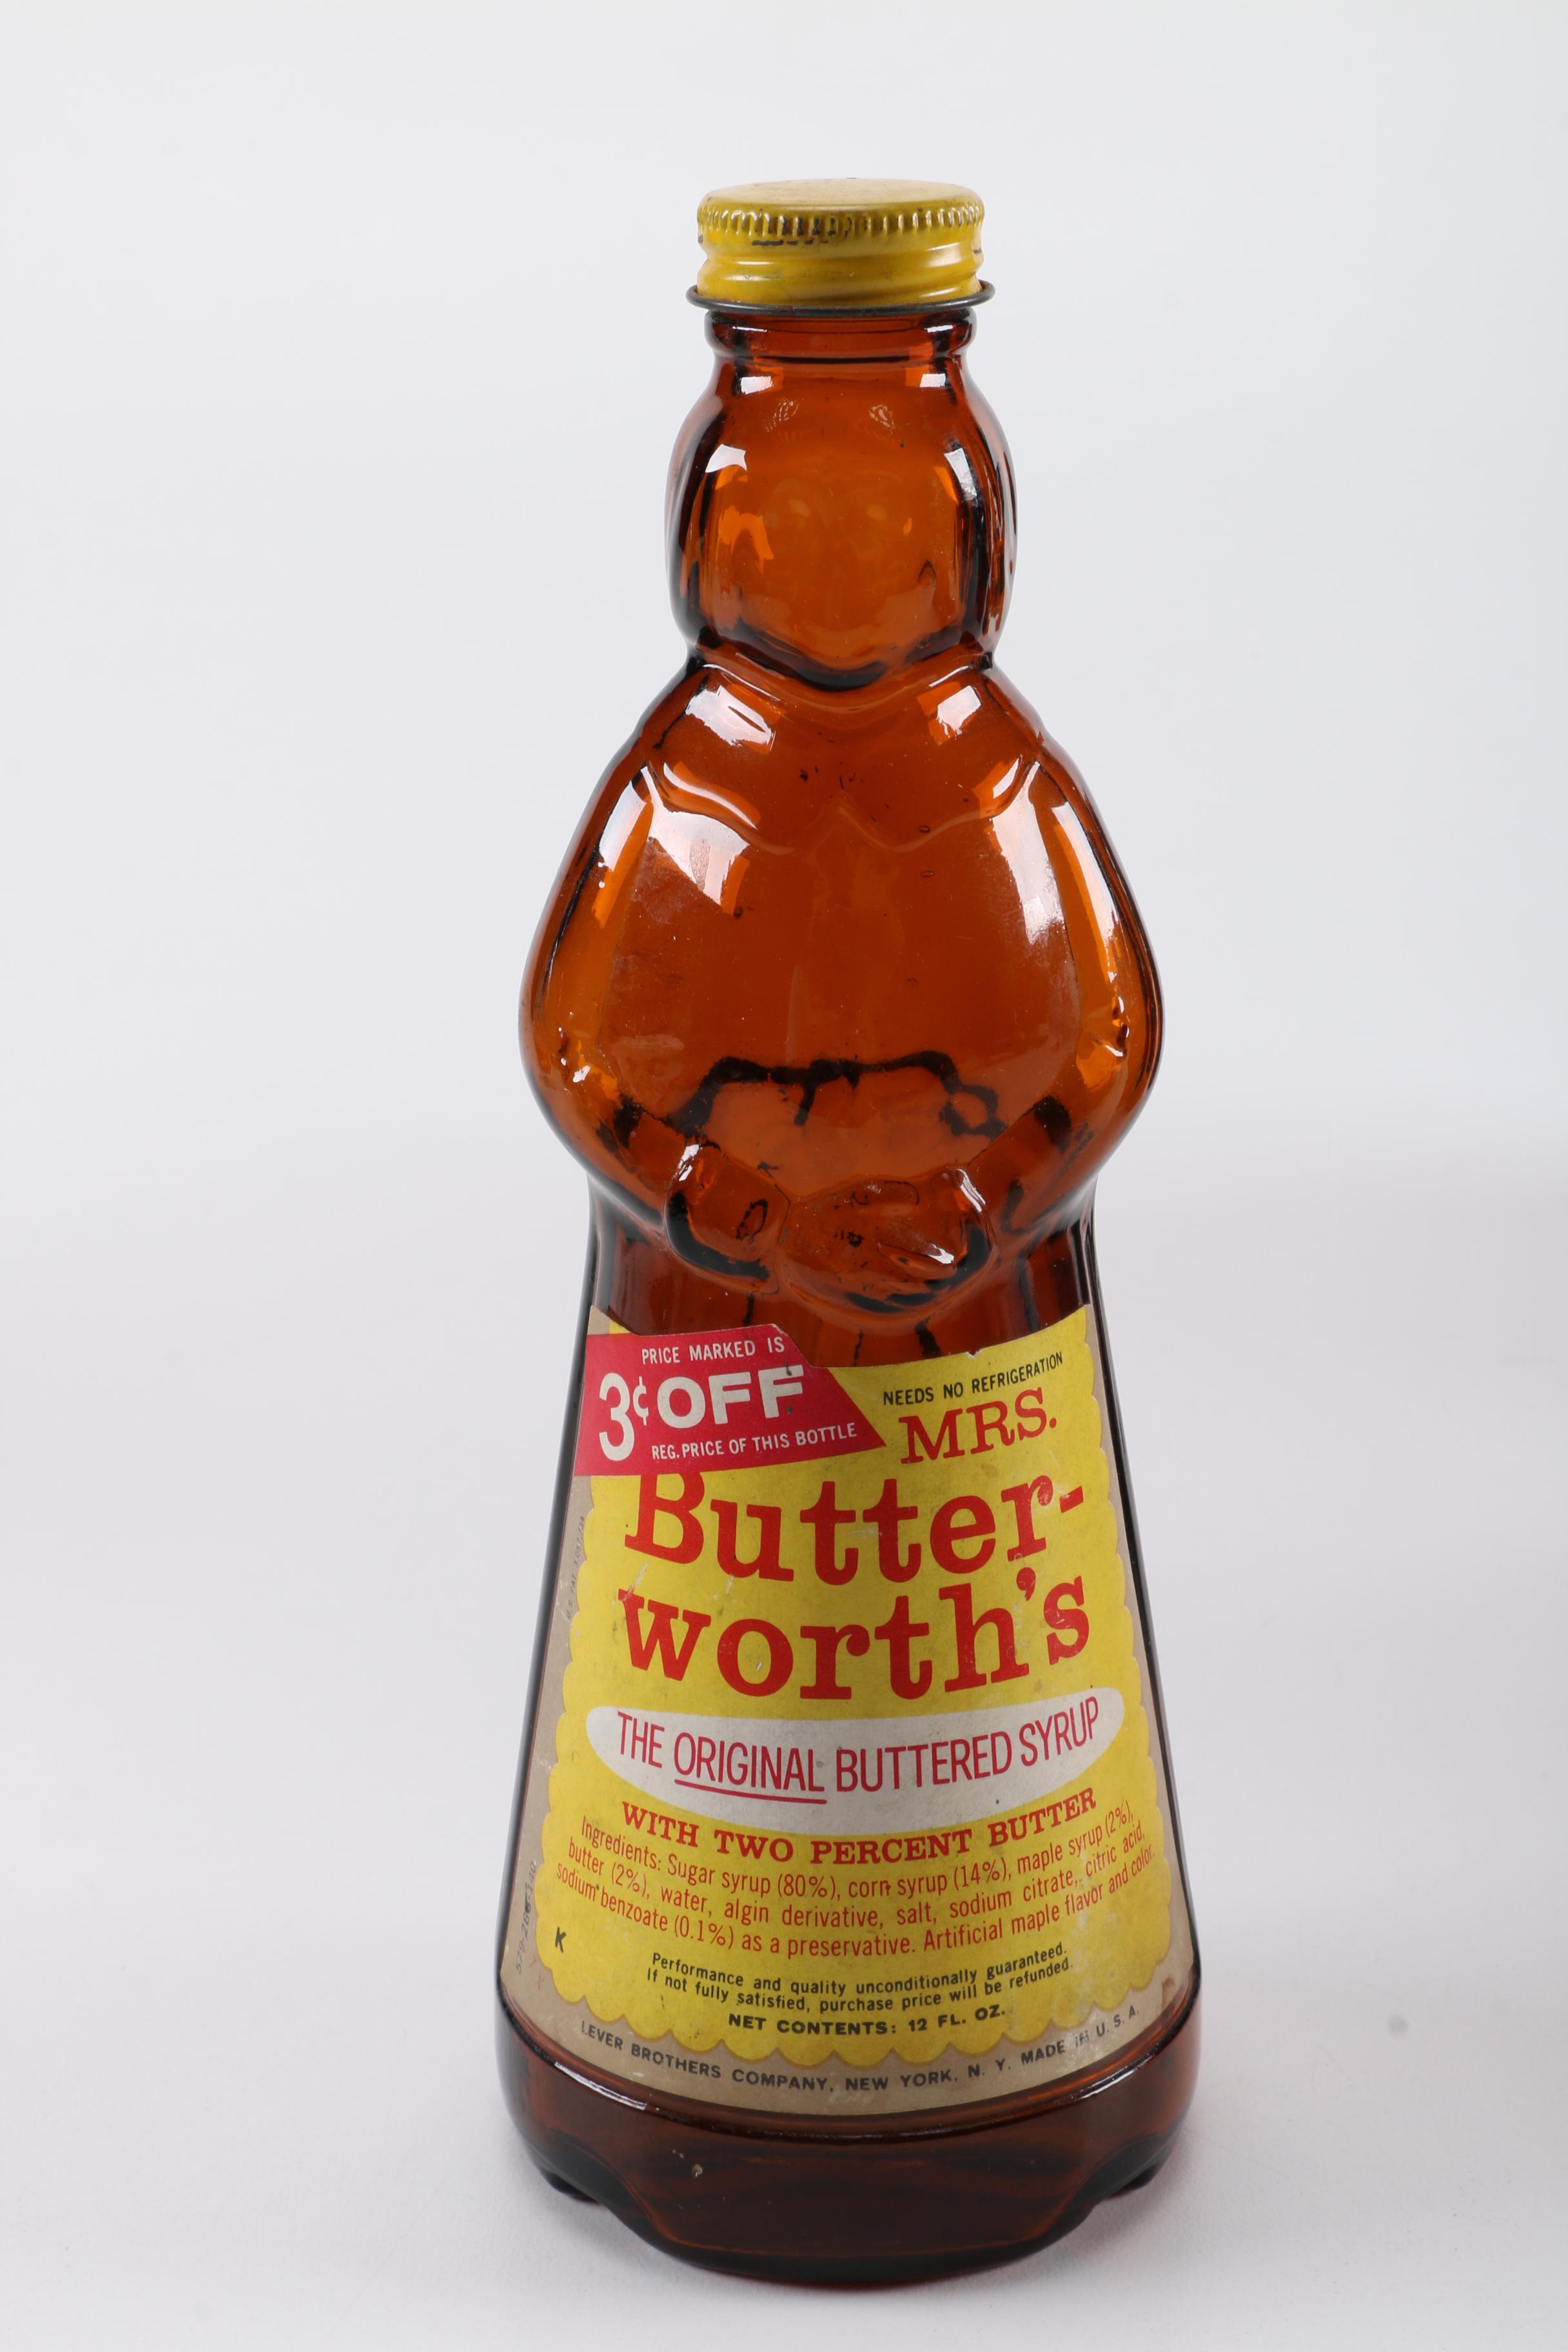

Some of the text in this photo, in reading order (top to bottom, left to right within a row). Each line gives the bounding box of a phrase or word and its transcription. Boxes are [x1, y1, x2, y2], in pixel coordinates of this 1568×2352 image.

[642, 1337, 785, 1365] PRICE MARKED IS
[883, 1351, 1063, 1406] NEEDS NO REFRIGERATION
[656, 1364, 804, 1429] OFF
[899, 1387, 1057, 1464] MRS.
[729, 1438, 747, 1455] OF
[748, 1434, 790, 1452] THIS
[796, 1423, 857, 1446] BOTTLE
[625, 1472, 1084, 1585] Butter-
[618, 1567, 1090, 1700] worth's
[618, 1696, 1099, 1792] THE ORIGINAL BUTTERED SYRUP
[582, 1800, 1133, 1901] Ingredients: Sugar syrup (80%), corn syrup (14%), maple syrup (2%),
[622, 1787, 1096, 1864] WITH TWO PERCENT BUTTER
[569, 1819, 1144, 1930] butter (2%), water, algin derivative, salt, sodium citrate, citric acid,
[554, 1926, 567, 1953] K
[557, 1863, 596, 1902] sodium
[601, 1886, 668, 1932] benzoate
[674, 1914, 734, 1950] (0.1%)
[742, 1934, 762, 1952] as
[770, 1937, 779, 1954] a
[788, 1934, 916, 1959] preservative.
[924, 1918, 1003, 1952] Artificial
[1012, 1905, 1059, 1935] maple
[1064, 1883, 1102, 1916] flavor
[1109, 1862, 1128, 1894] and
[647, 1957, 1073, 2014] If not fully satisfied, purchase price will be refunded.
[652, 1942, 1067, 1997] Performance and quality unconditionally guaranteed.
[729, 2004, 1005, 2035] NET CONTENTS: 12 FL. OZ.
[582, 2021, 623, 2050] LEVER
[631, 2044, 721, 2079] BROTHERS
[845, 2077, 888, 2091] NEW
[1021, 2039, 1066, 2065] MADE
